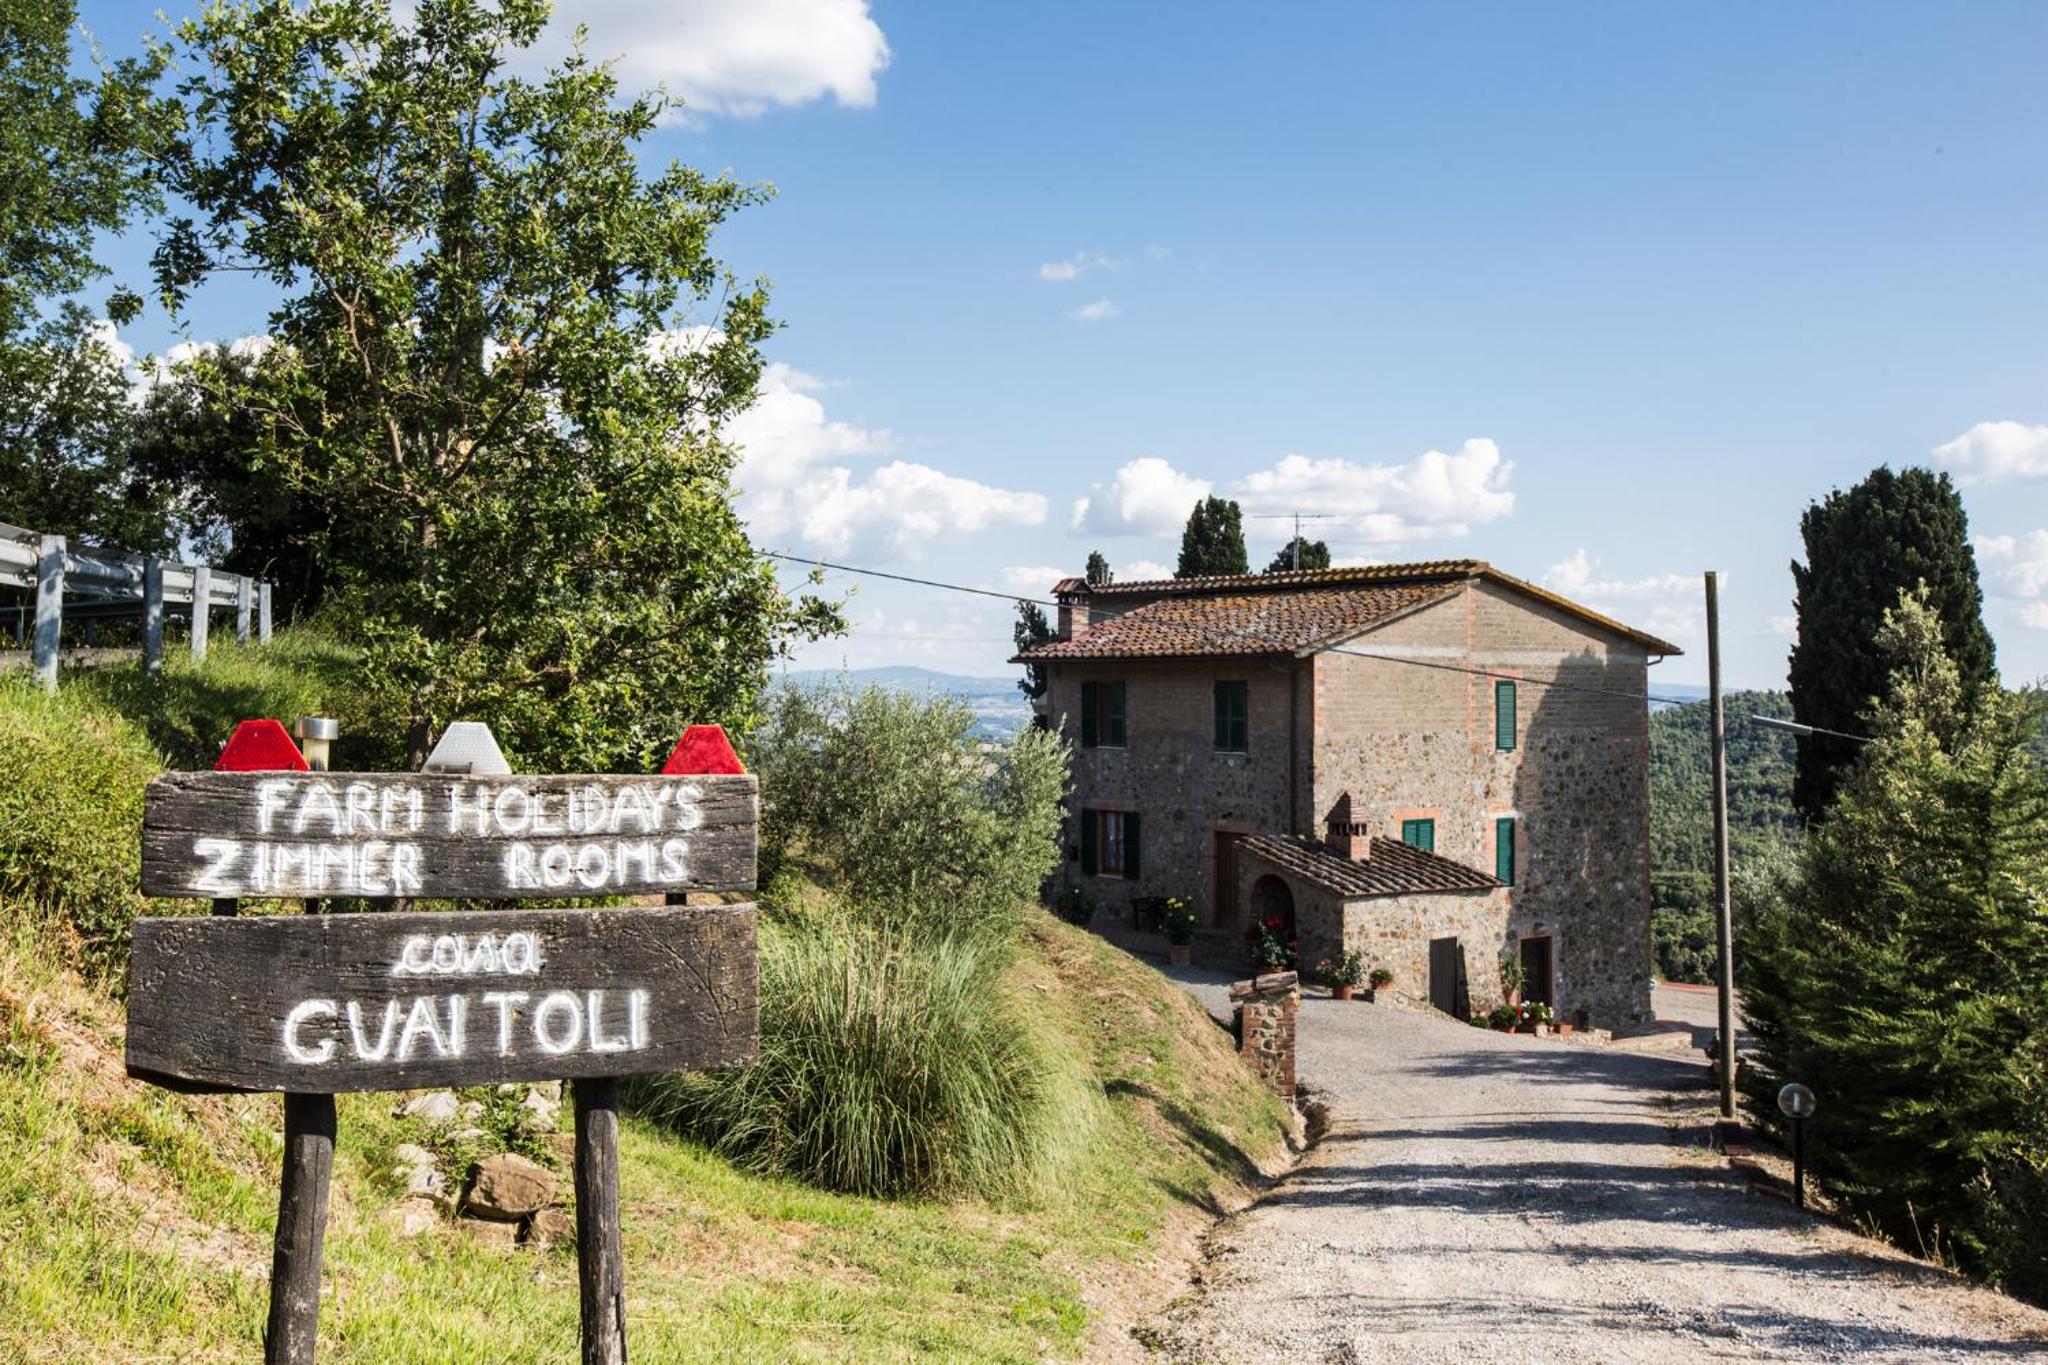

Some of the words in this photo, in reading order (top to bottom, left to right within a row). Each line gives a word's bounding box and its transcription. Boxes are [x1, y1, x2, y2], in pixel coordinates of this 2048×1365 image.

[256, 780, 425, 836] FARM
[447, 783, 705, 836] HOLIDAYS
[191, 837, 425, 897] ZIMMER
[503, 838, 690, 889] ROOMS
